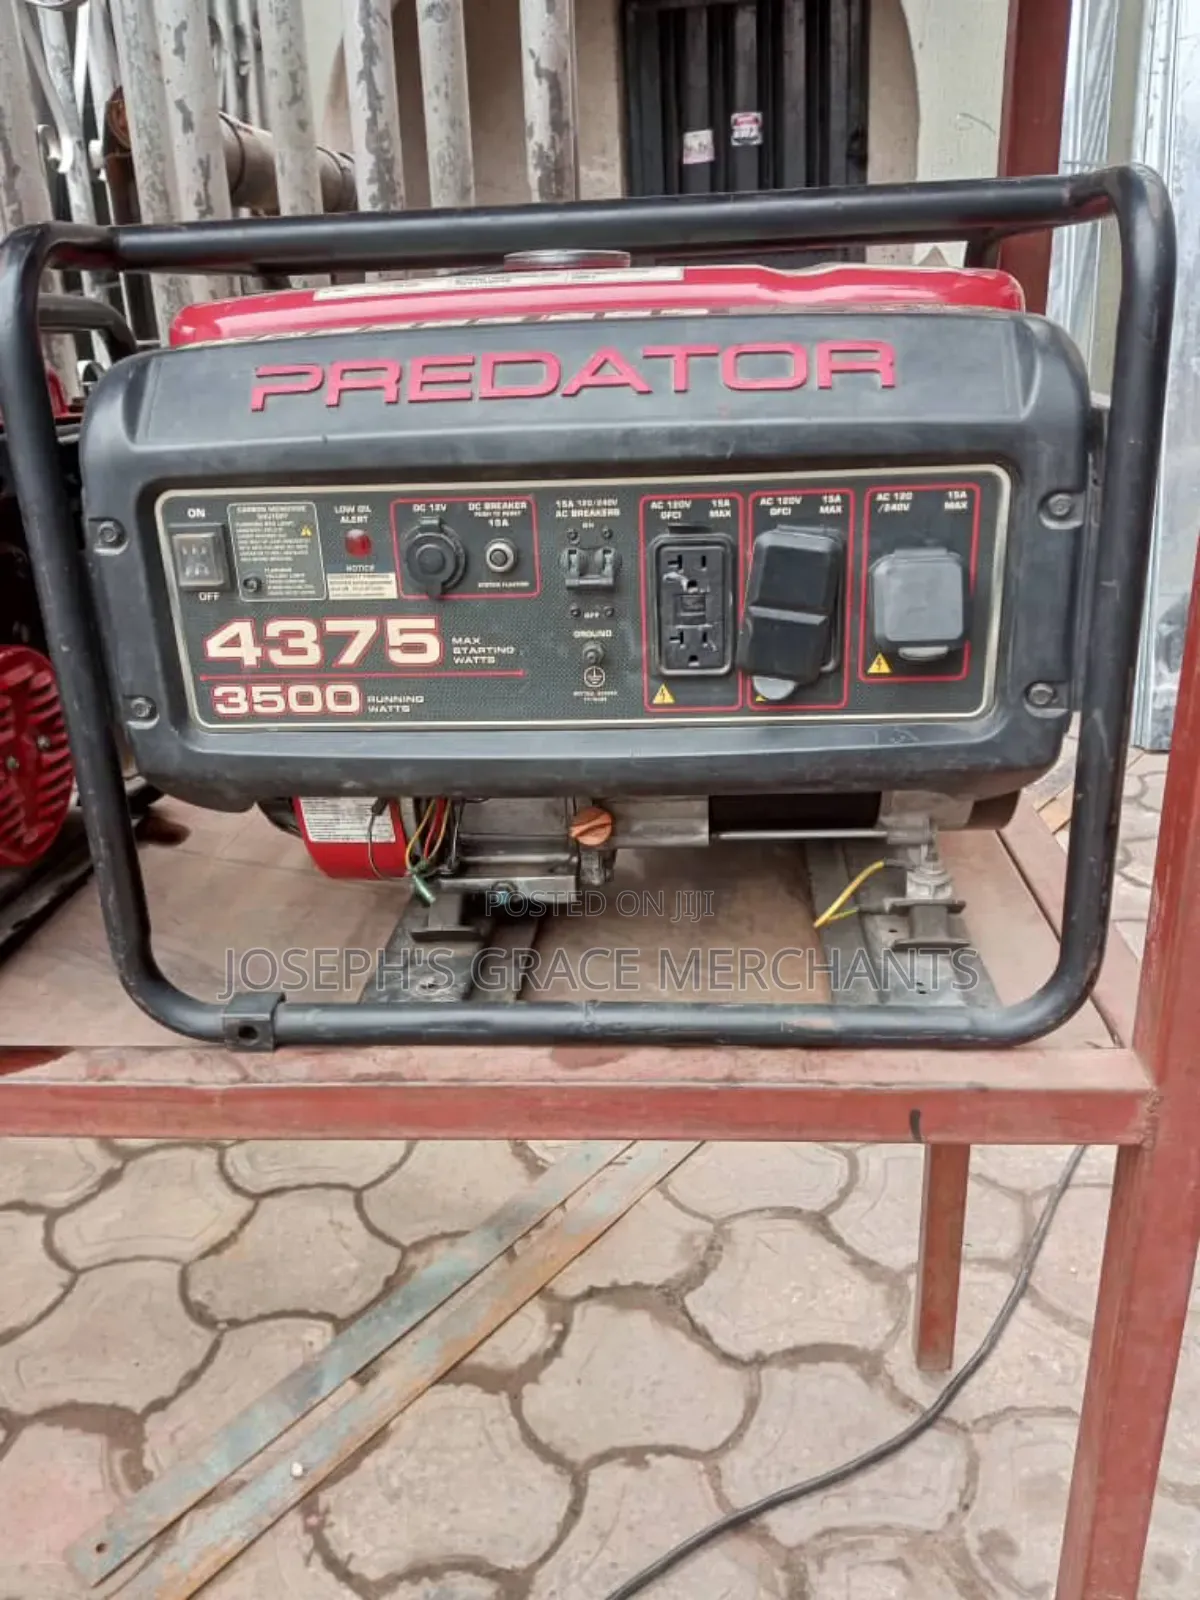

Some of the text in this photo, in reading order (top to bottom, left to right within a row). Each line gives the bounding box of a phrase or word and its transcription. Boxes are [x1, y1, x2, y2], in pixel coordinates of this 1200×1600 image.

[251, 340, 897, 413] PREDATOR
[822, 495, 842, 504] 15A
[876, 492, 913, 501] AC 120
[947, 491, 968, 499] 15A
[556, 500, 574, 508] 15A
[650, 500, 692, 510] AC 120V
[711, 499, 730, 508] 15A
[760, 496, 802, 506] AC 120V
[944, 501, 968, 510] MAX
[334, 505, 372, 514] LOW OIL
[413, 504, 427, 512] DC
[468, 501, 527, 511] DC BREAKER
[819, 506, 842, 514] MAX
[187, 508, 205, 518] ON
[555, 508, 621, 518] AC BREAKERS
[709, 509, 732, 518] MAX
[340, 515, 368, 524] ALERT
[346, 564, 375, 572] NOTICE
[199, 592, 220, 601] OFF
[573, 630, 612, 638] GROUND
[204, 615, 445, 669] 4375
[452, 637, 481, 645] MAX
[453, 646, 515, 655] STARTING
[453, 655, 496, 665] WATTS
[211, 683, 363, 715] 3500
[367, 695, 425, 704] RUNNING
[368, 704, 411, 713] WATTS
